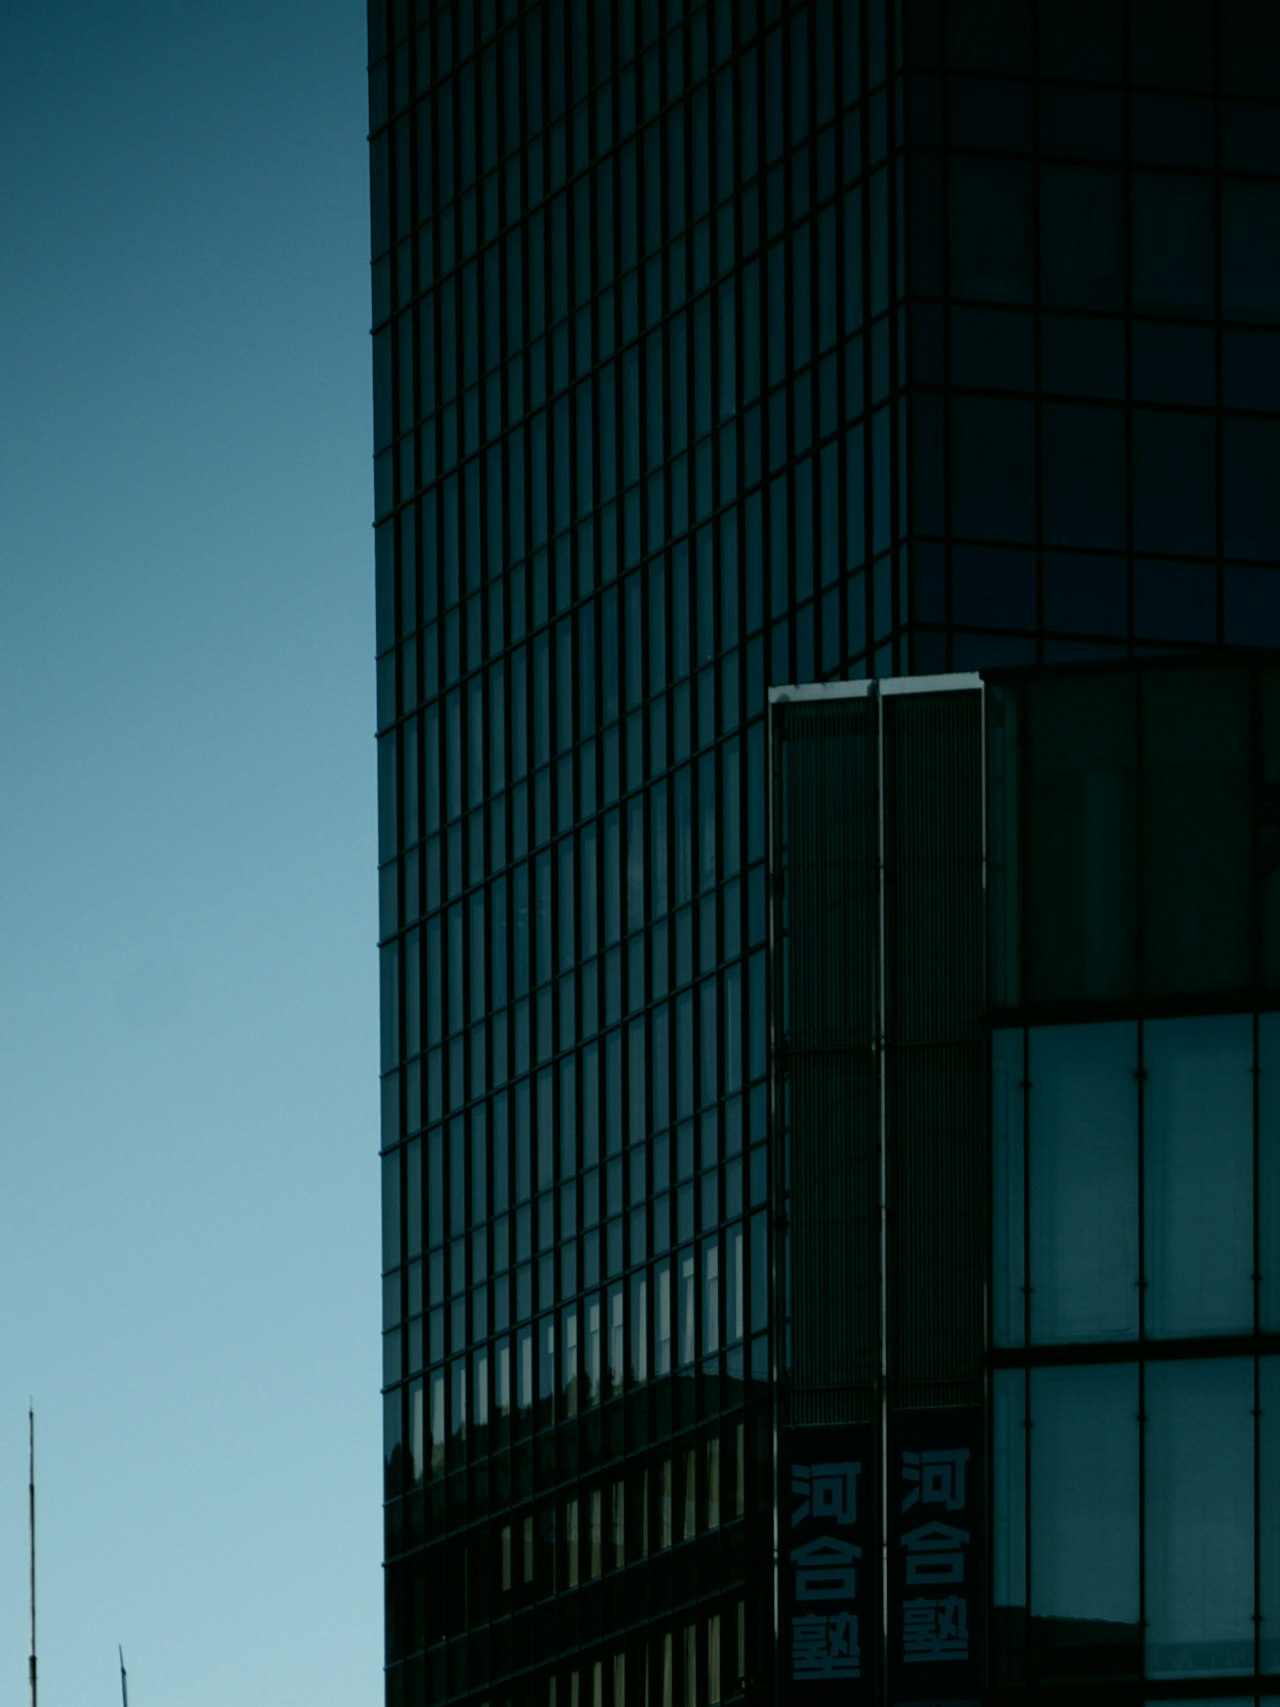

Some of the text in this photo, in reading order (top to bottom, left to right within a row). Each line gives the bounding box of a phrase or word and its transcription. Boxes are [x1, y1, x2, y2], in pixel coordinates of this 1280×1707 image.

[790, 1460, 864, 1681] 河合塾
[901, 1448, 970, 1663] 河合塾
